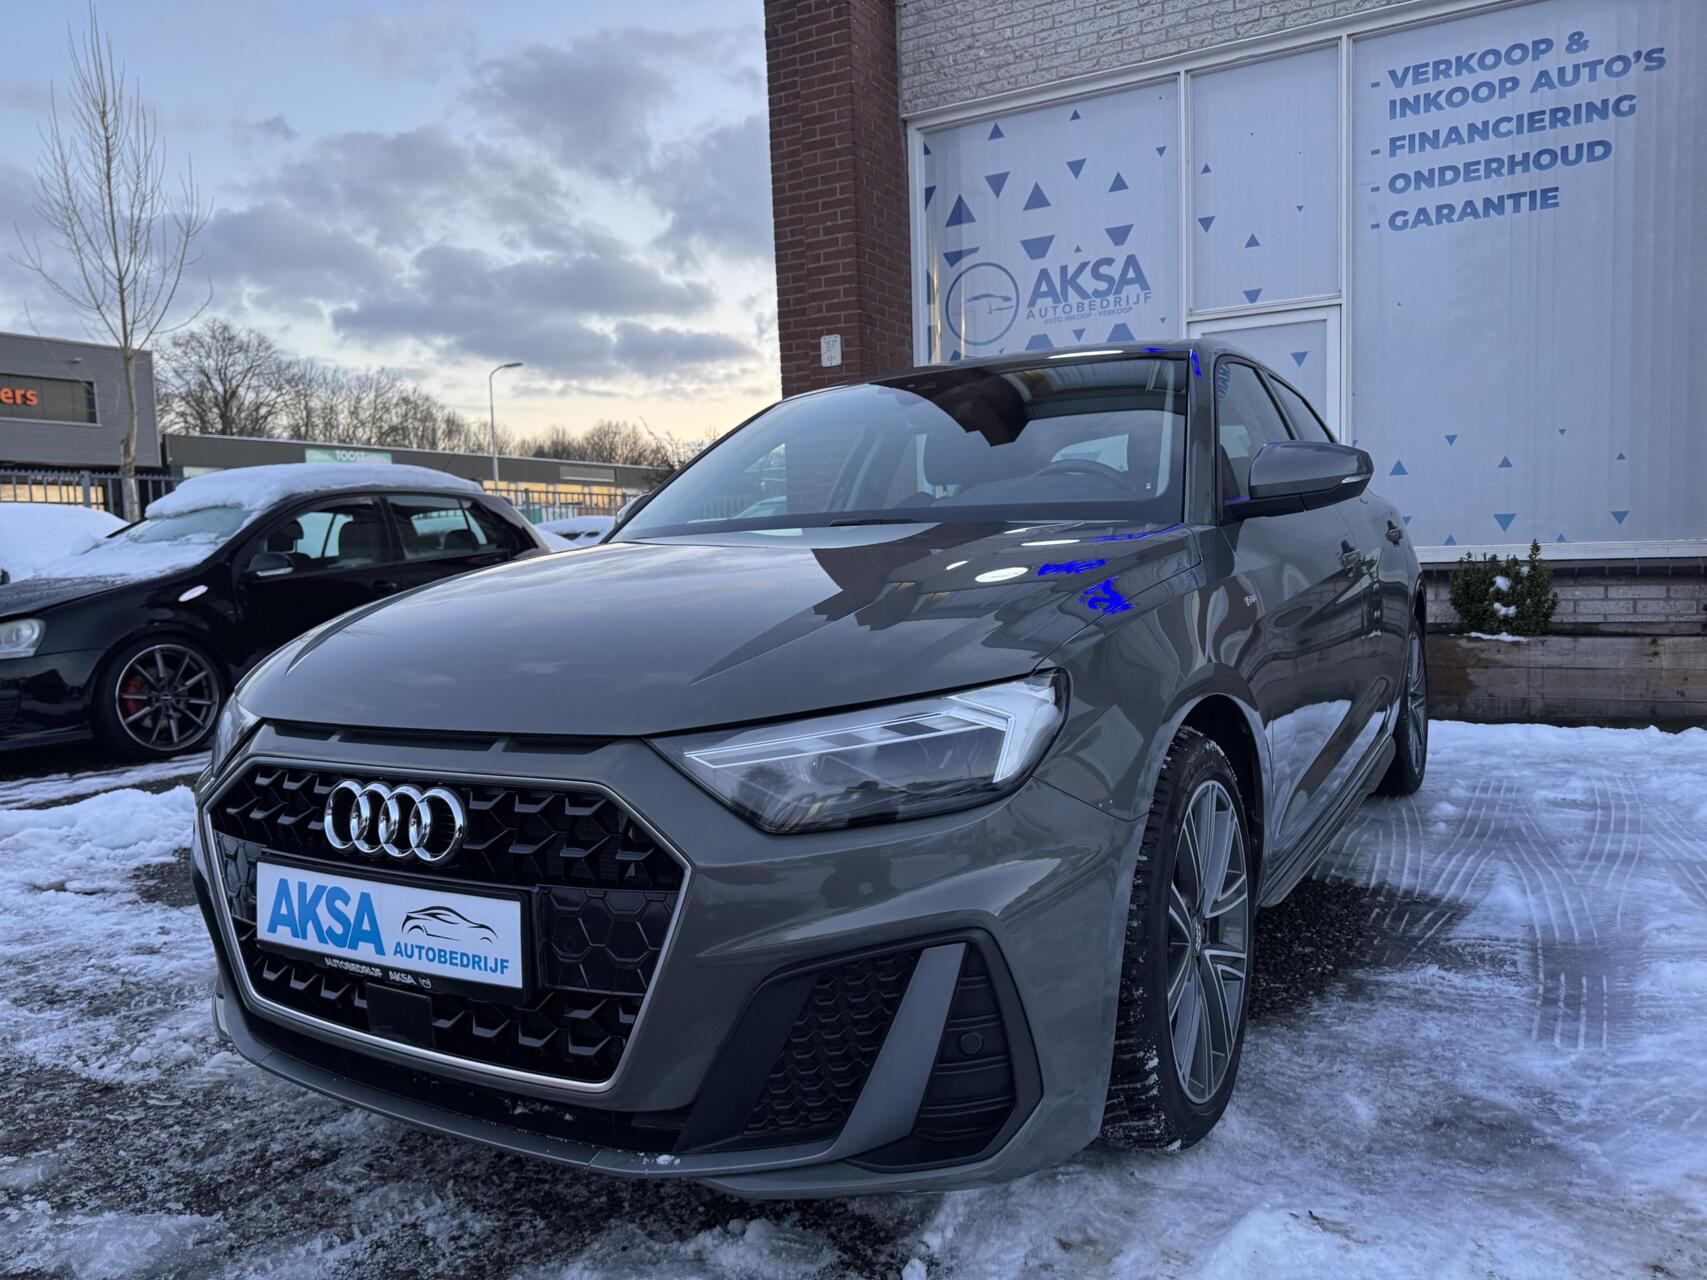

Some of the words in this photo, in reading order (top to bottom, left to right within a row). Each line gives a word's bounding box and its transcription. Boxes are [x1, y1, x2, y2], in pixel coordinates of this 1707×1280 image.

[1387, 37, 1554, 89] VERKOOP
[1565, 31, 1590, 54] &
[1389, 76, 1520, 120] INKOOP
[1530, 47, 1666, 94] AUTO'S
[1389, 94, 1636, 158] FINANCIERING
[1388, 139, 1612, 194] ONDERHOUD
[1388, 186, 1560, 232] GARANTIE
[1026, 292, 1151, 320] AUTOBEDRIJF
[1027, 254, 1151, 308] AKSA
[1043, 317, 1064, 325] AUTO
[1064, 313, 1092, 322] INKOOP
[1098, 306, 1133, 317] VERKOOP
[0, 388, 38, 406] ers
[266, 878, 386, 956] AKSA
[324, 957, 383, 977] AUTOBEDRIJF
[388, 971, 417, 985] AKSA
[393, 941, 510, 975] AUTOBEDRIJF
